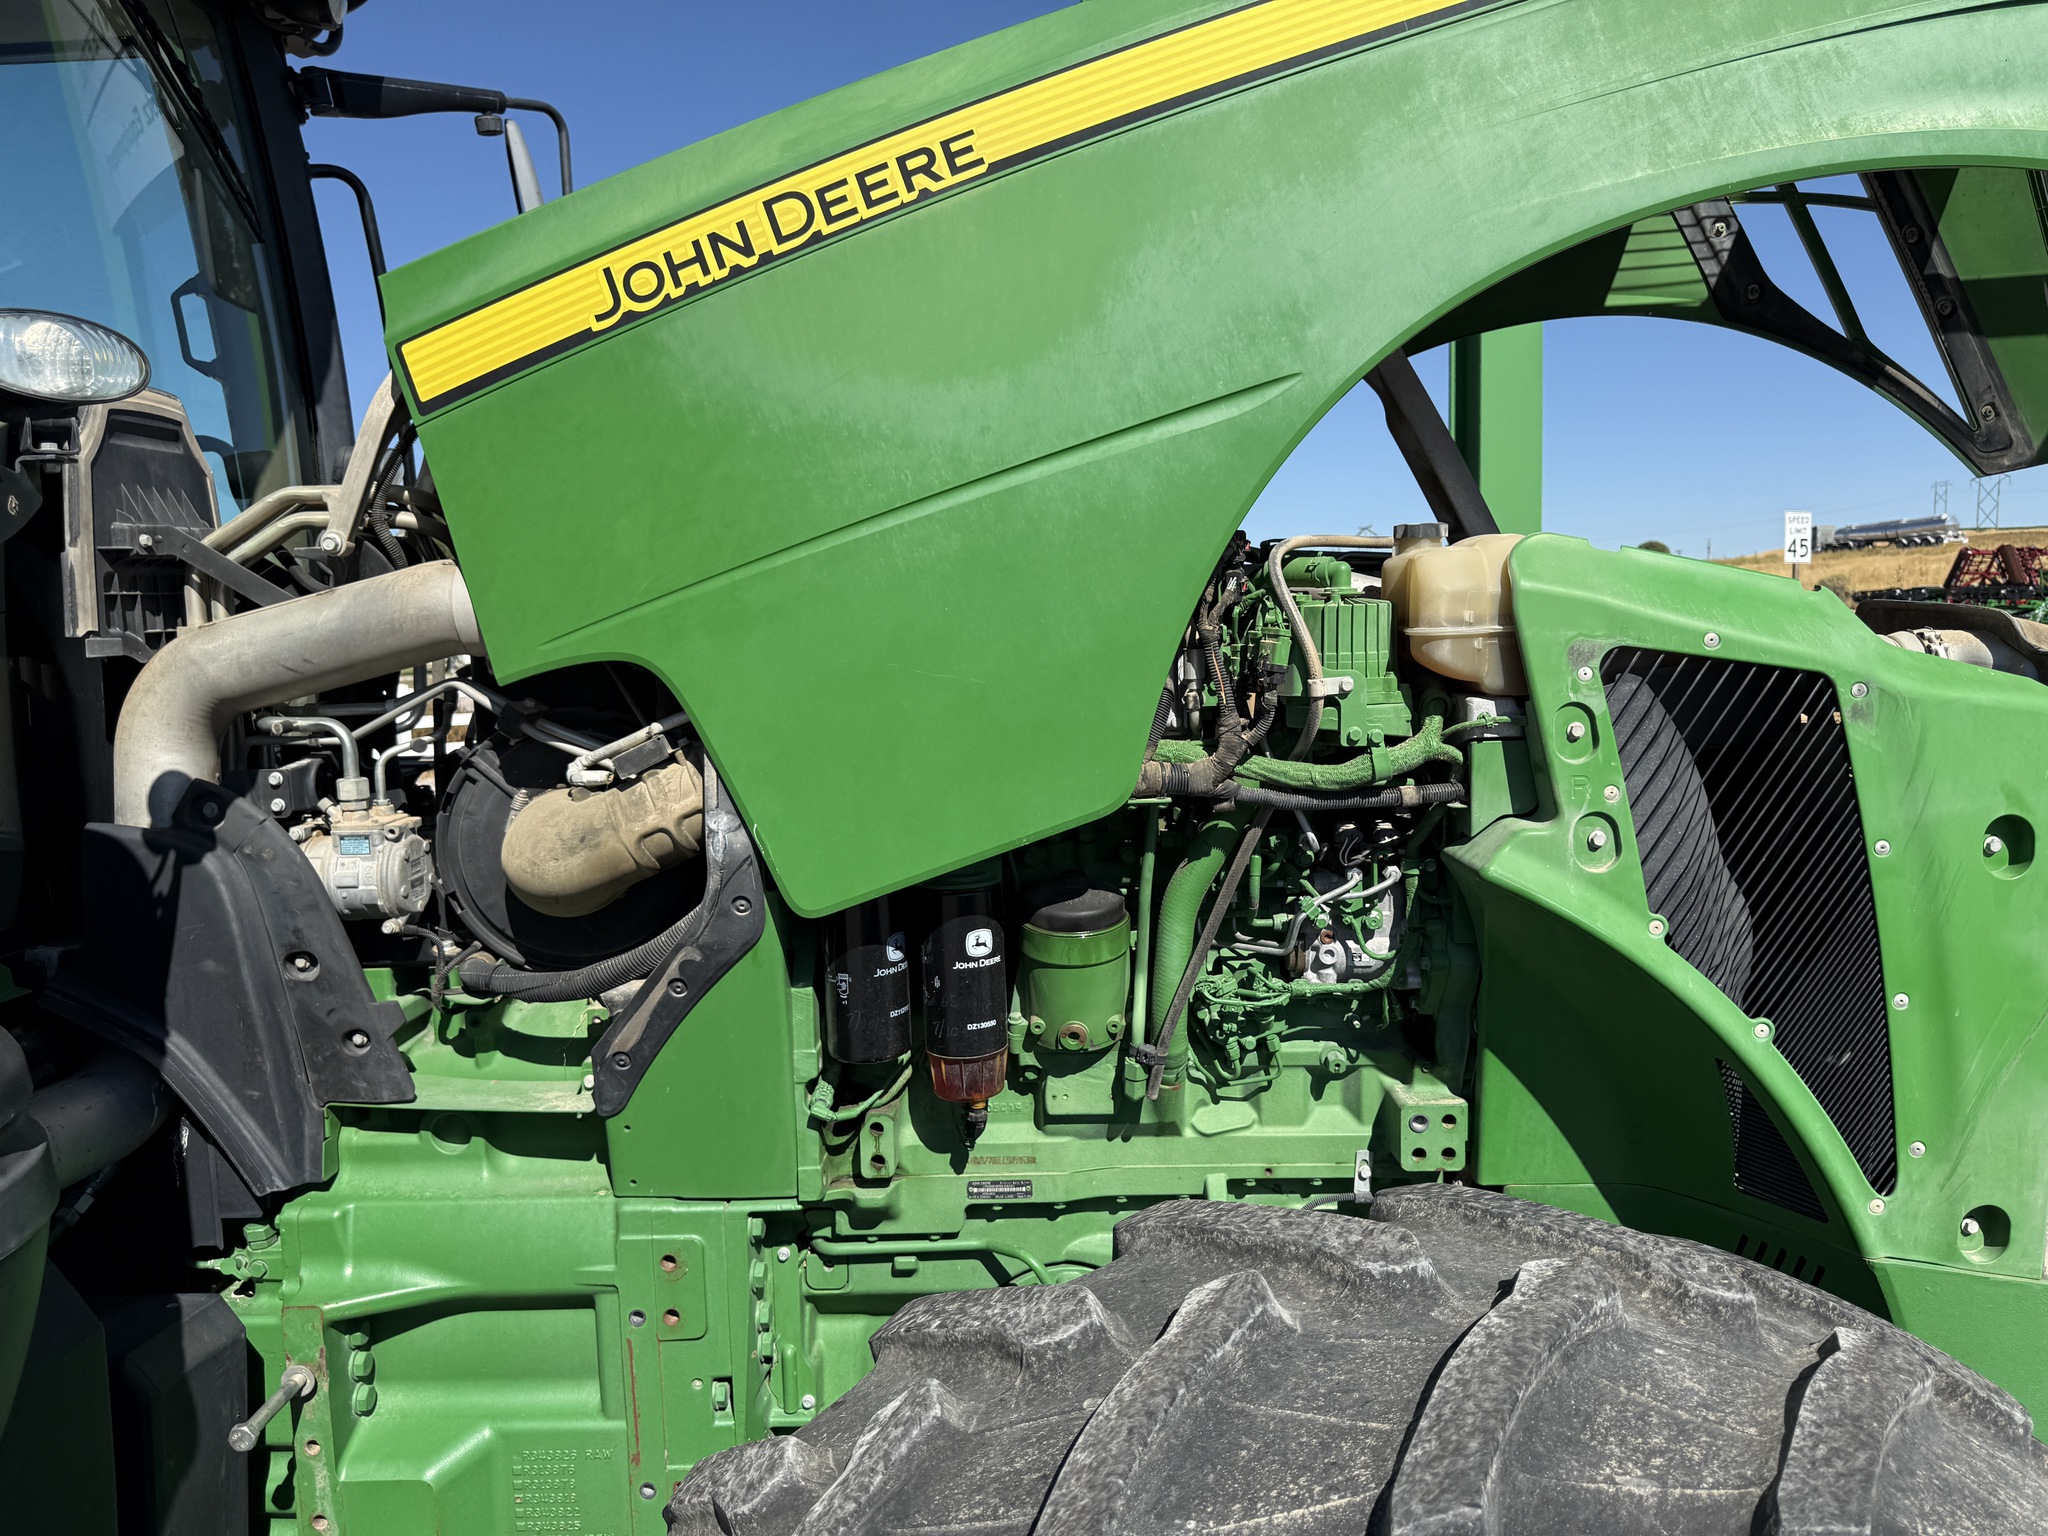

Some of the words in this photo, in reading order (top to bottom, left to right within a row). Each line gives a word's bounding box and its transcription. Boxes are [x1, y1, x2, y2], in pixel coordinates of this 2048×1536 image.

[594, 220, 756, 323] JOHN
[763, 129, 986, 246] DEERE
[1788, 516, 1810, 525] SPEED
[1789, 527, 1807, 535] LIMIT
[1787, 538, 1809, 558] 45
[1570, 774, 1591, 800] R
[952, 961, 978, 970] JOHN
[979, 955, 1001, 967] DEERE
[874, 964, 898, 978] JOHN
[585, 1448, 613, 1460] RAW
